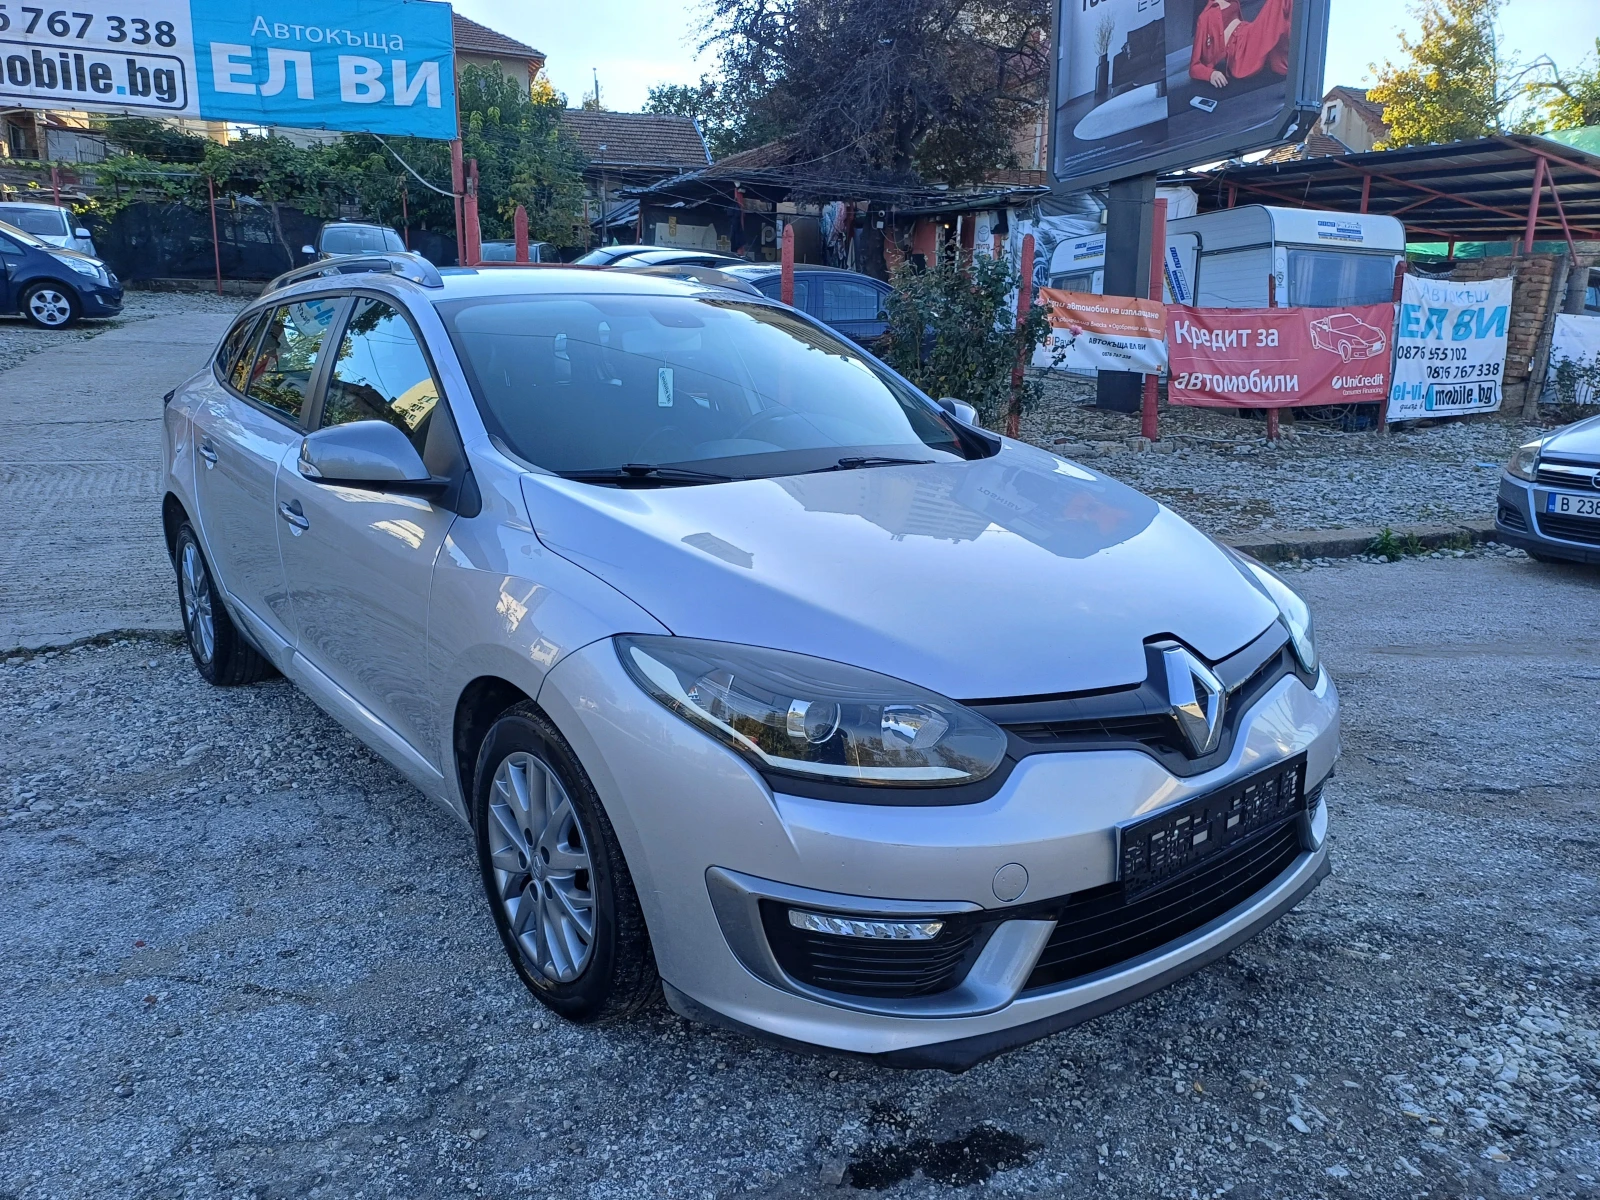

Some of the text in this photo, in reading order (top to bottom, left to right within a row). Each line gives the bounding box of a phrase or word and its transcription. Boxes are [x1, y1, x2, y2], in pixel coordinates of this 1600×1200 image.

[21, 6, 94, 39] 767
[106, 15, 177, 48] 338
[250, 15, 404, 54] Автокъща
[209, 41, 442, 109] ЕЛ ВИ
[1066, 302, 1109, 314] автомобил
[1110, 307, 1120, 315] на
[1399, 303, 1508, 342] ЕЛ ВИ
[1088, 336, 1129, 350] АВТОКЪЩА
[1174, 320, 1279, 352] Кредит за
[1397, 345, 1425, 360] 0876
[1174, 369, 1299, 393] автомобили
[1342, 373, 1384, 389] UniCredit
[1476, 363, 1500, 377] 338
[1434, 384, 1493, 406] mobile.bg
[1560, 497, 1570, 511] B
